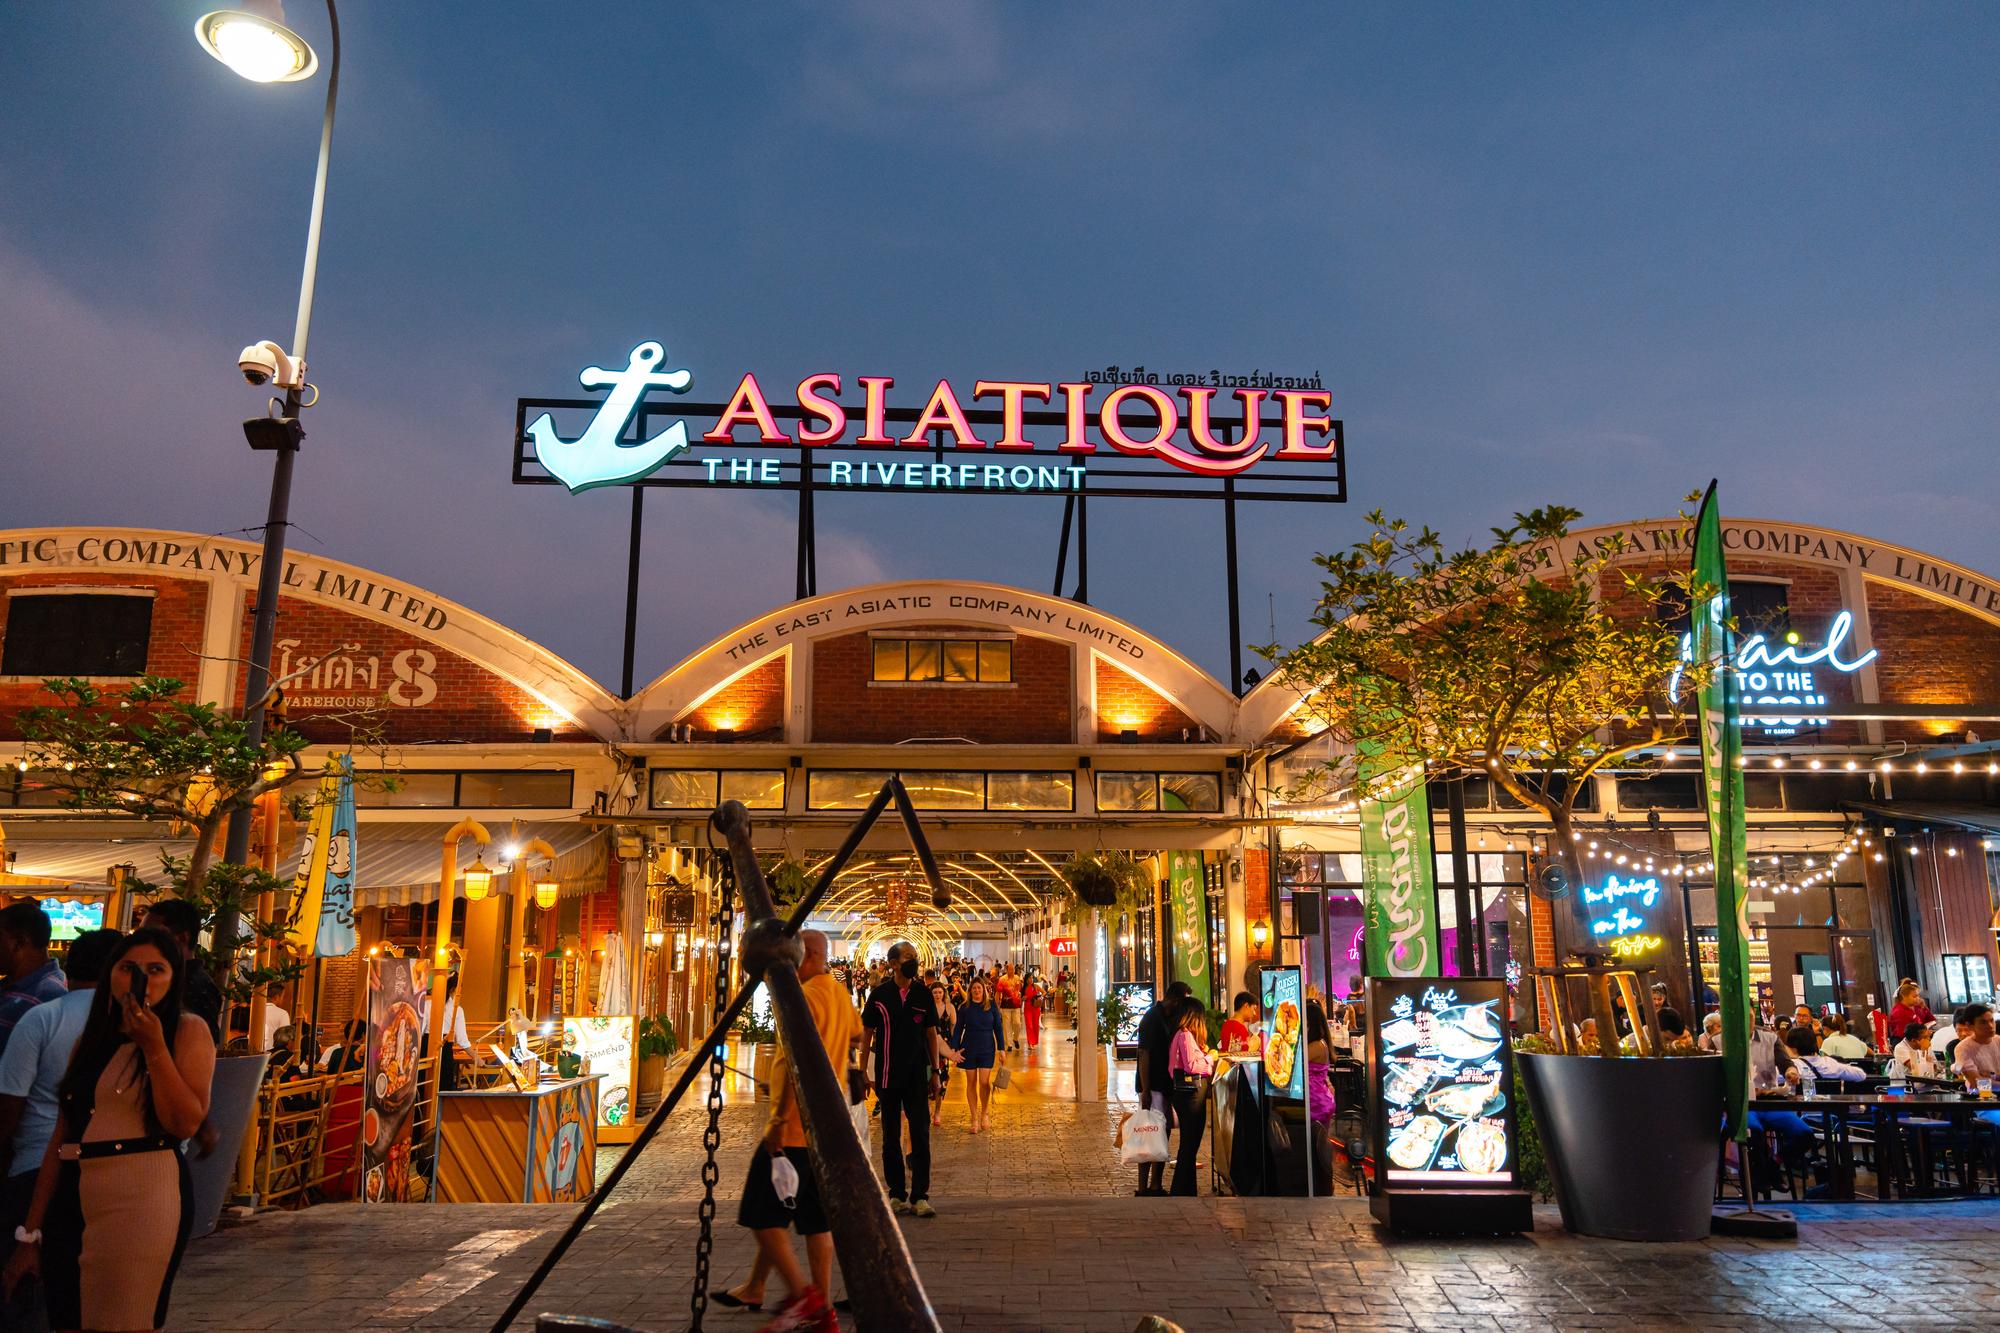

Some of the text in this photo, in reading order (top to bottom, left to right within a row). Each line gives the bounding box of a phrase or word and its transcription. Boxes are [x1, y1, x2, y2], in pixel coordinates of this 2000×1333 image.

[702, 371, 1336, 476] ASIATIQUE
[702, 458, 1087, 491] THE RIVERFRONT
[1721, 527, 1876, 569] COMPANY
[77, 537, 261, 576] COMPANY
[281, 562, 447, 631] LIMITED
[726, 596, 1144, 661] THE EAST ASIATIC COMPANY LIMITED
[388, 649, 438, 707] 8
[1736, 672, 1814, 691] TO THE
